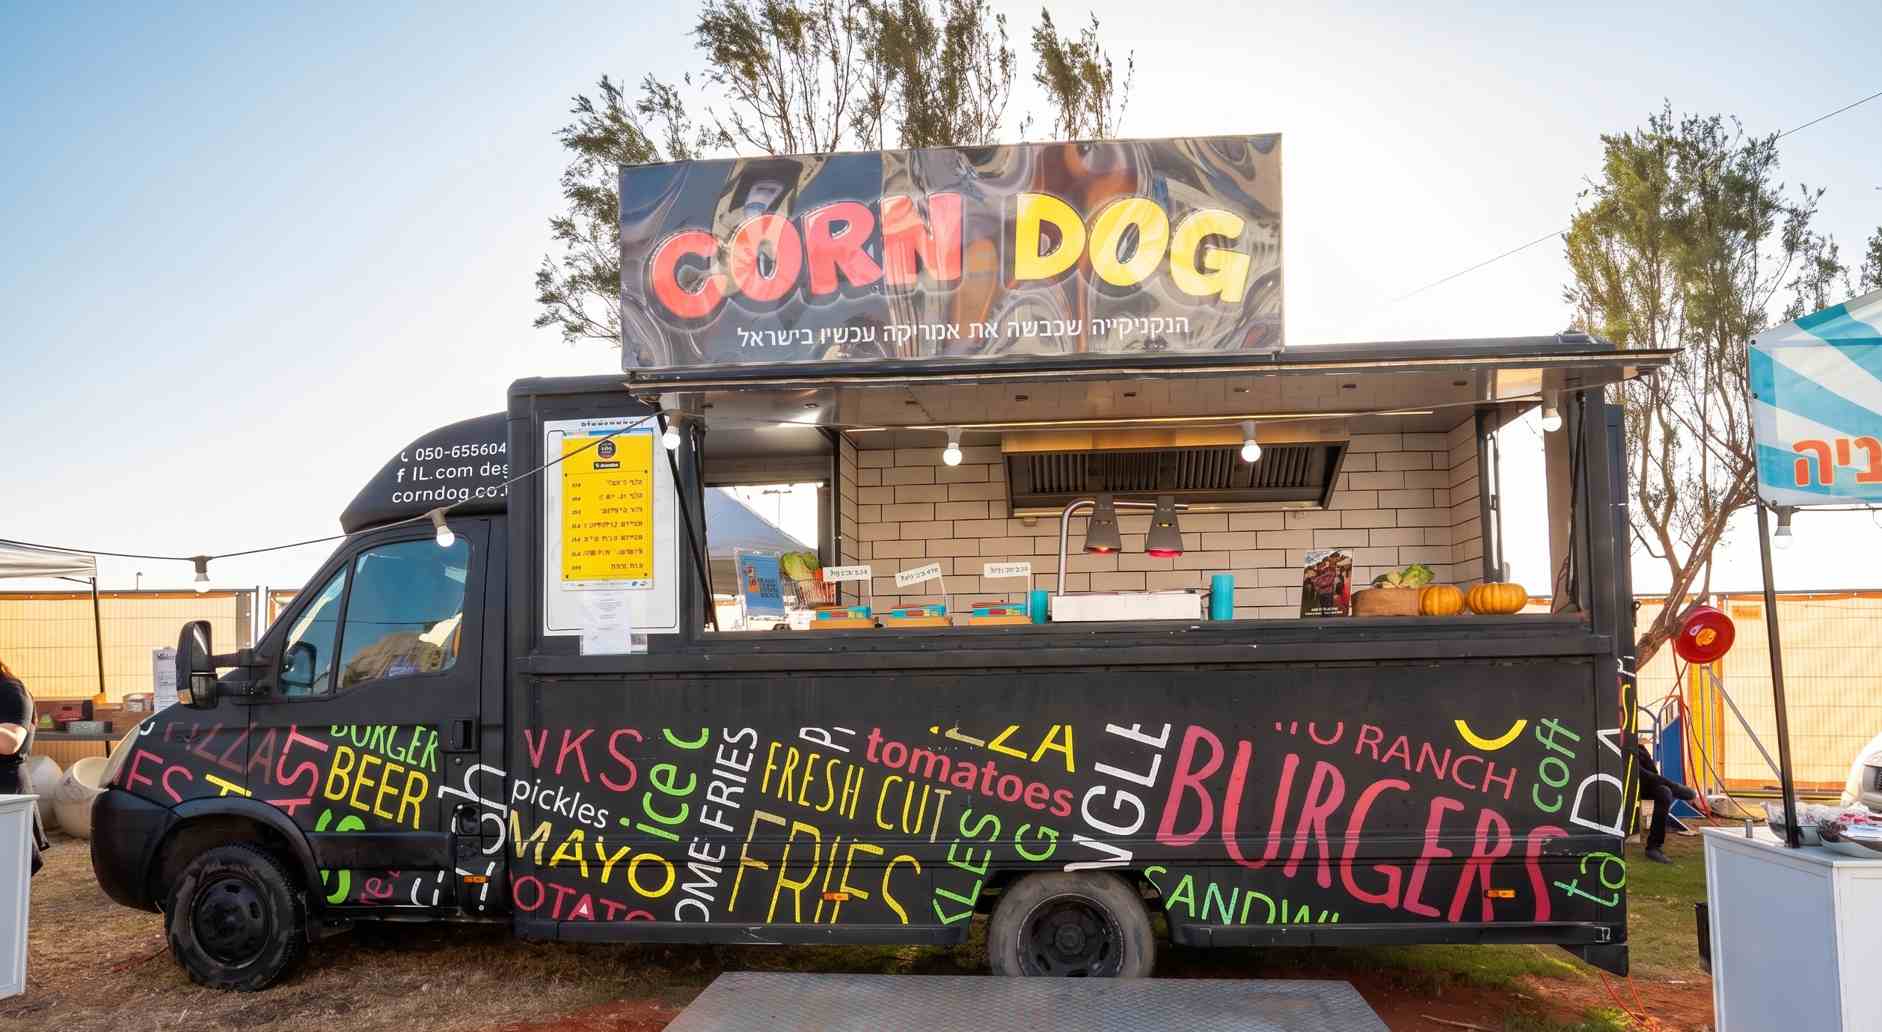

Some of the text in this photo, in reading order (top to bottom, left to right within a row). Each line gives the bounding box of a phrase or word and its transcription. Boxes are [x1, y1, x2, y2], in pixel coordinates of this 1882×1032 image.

[647, 191, 1252, 319] CORN DOG
[737, 316, 1190, 347] הנקניקייה שכבשה את אמריקה עכשיו בישראל
[415, 443, 506, 460] 050-655604
[323, 745, 430, 830] BEER
[510, 778, 610, 829] pickles
[699, 727, 758, 832] FRIES
[761, 741, 952, 844] FRESH CUT
[864, 727, 1074, 818] tomatoes
[1355, 723, 1518, 800] RANCH
[509, 808, 677, 899] MAYO
[727, 809, 922, 925] FRIES
[1154, 724, 1568, 923] BURGERS
